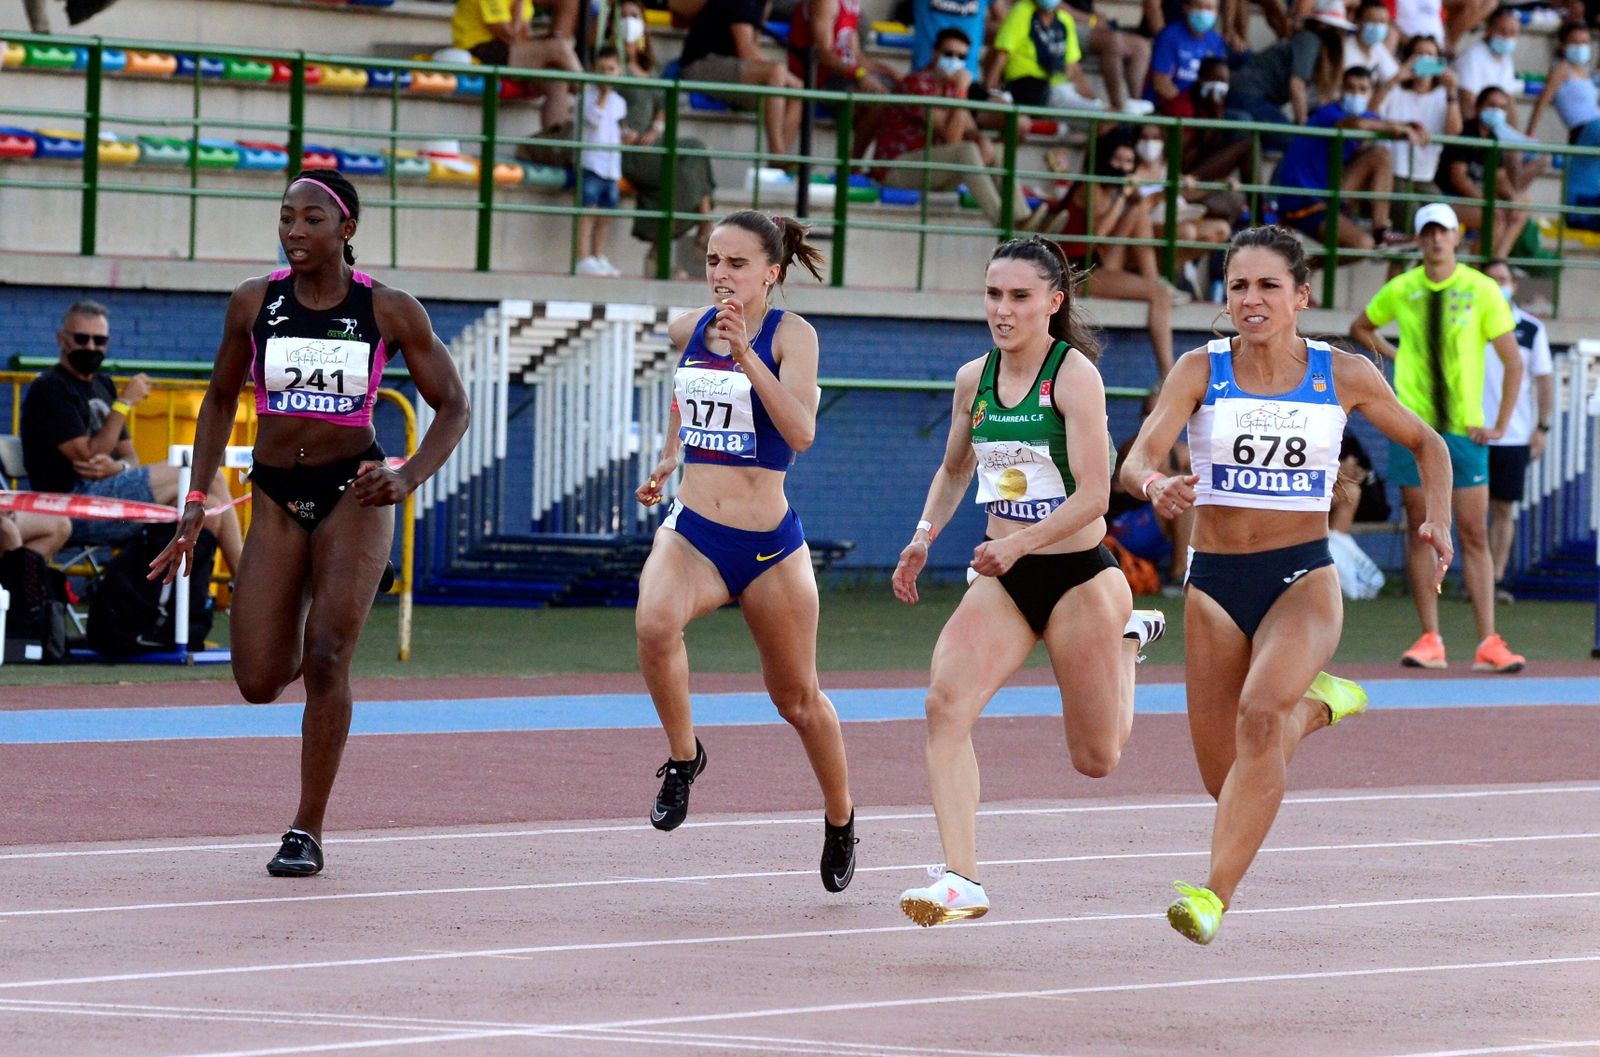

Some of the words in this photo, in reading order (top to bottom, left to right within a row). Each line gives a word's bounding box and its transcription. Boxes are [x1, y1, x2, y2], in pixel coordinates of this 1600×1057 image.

[284, 367, 344, 394] 241
[686, 399, 732, 429] 277
[988, 414, 1029, 423] VILLARREAL
[1233, 434, 1307, 468] 678
